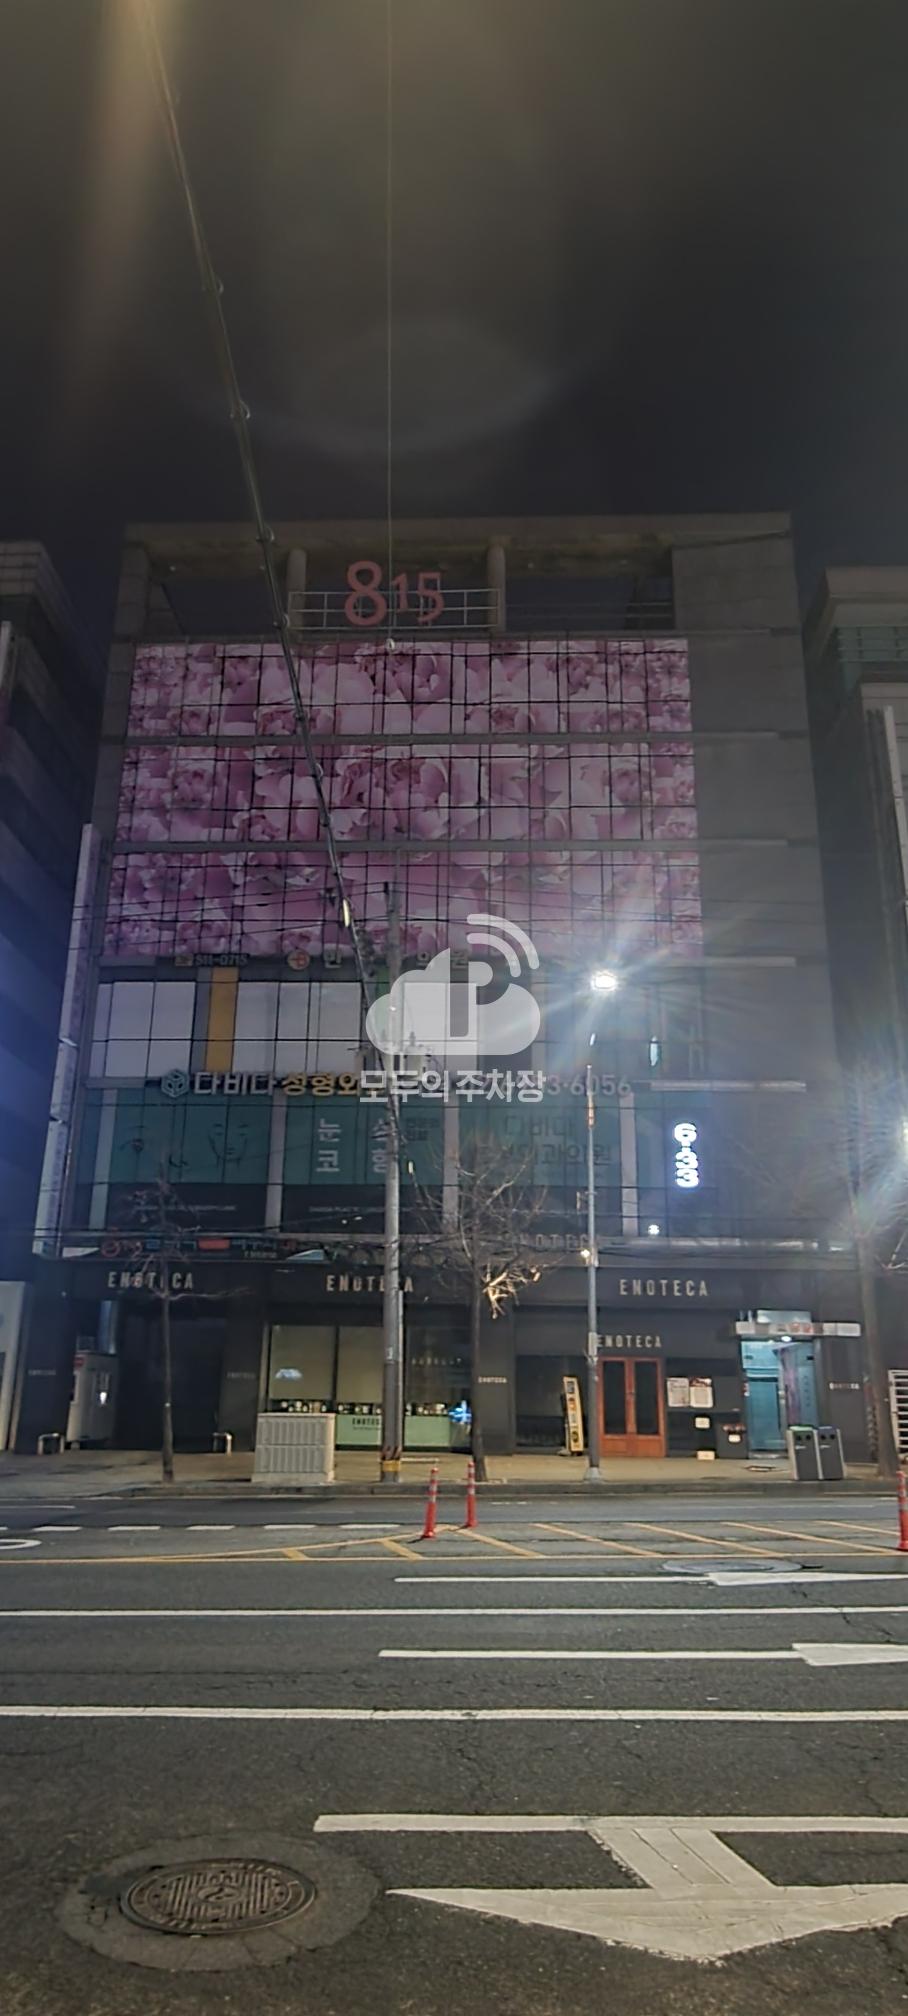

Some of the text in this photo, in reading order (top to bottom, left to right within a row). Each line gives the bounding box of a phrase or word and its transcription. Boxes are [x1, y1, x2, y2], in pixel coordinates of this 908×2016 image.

[344, 560, 445, 626] 815
[194, 1071, 277, 1096] 다비다
[619, 1278, 709, 1297] ENOTECA
[596, 1334, 662, 1348] ENOTECA
